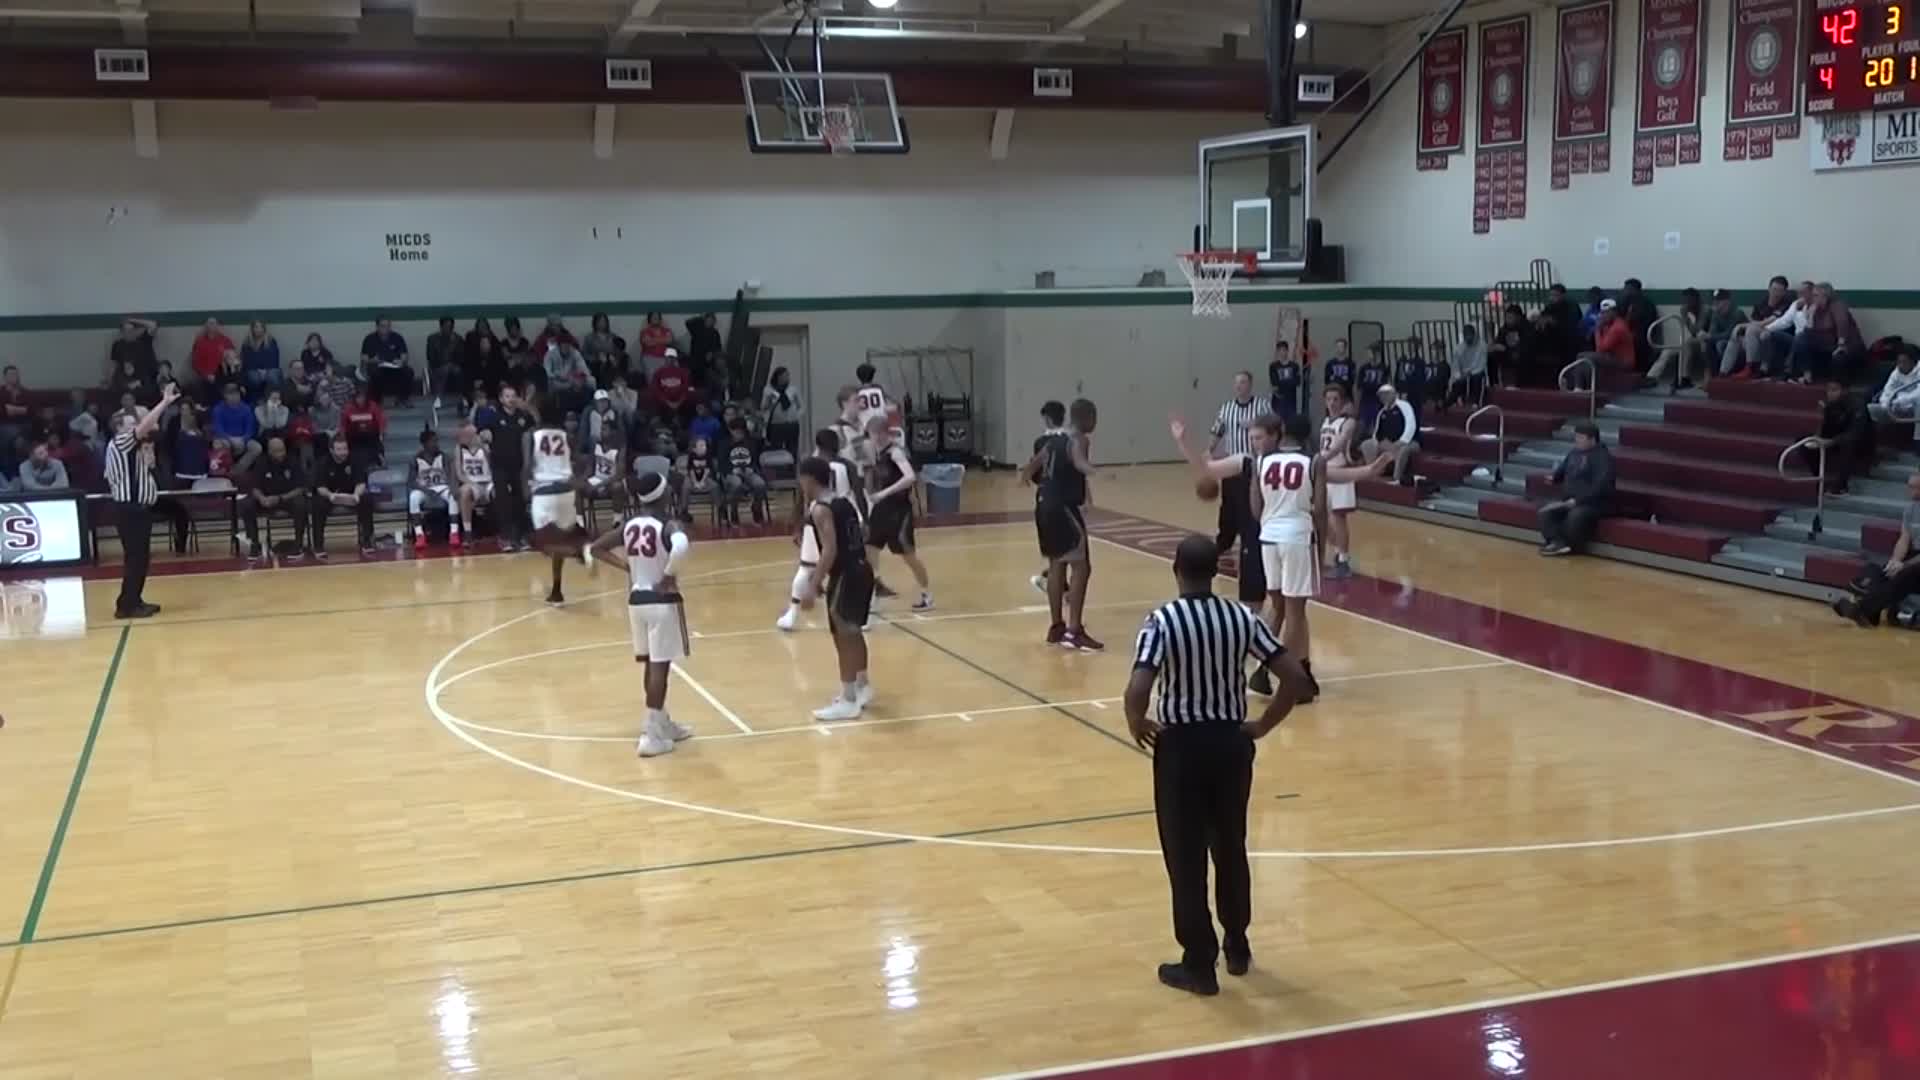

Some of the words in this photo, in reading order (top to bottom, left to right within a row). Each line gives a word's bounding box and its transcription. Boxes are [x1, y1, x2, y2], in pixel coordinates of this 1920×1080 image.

[1823, 9, 1857, 45] 42
[1886, 6, 1900, 35] 3
[1810, 51, 1837, 66] FOULS
[1861, 43, 1895, 59] PLAYER
[1865, 57, 1894, 88] 20
[1910, 55, 1917, 80] 1
[1820, 67, 1833, 90] 4
[1750, 81, 1775, 97] Field
[1873, 90, 1905, 105] MATCH
[1656, 95, 1680, 112] Boys
[1744, 98, 1780, 113] Hockey
[1808, 98, 1835, 113] SCORE
[1656, 109, 1677, 122] Golf
[1886, 111, 1920, 140] MI
[1725, 144, 1745, 158] 2014
[1876, 140, 1918, 157] SPORTS
[385, 232, 431, 247] MICDS
[390, 247, 429, 262] Home
[858, 392, 881, 411] 30
[540, 434, 566, 457] 42
[1264, 461, 1304, 491] 40
[625, 524, 658, 558] 23
